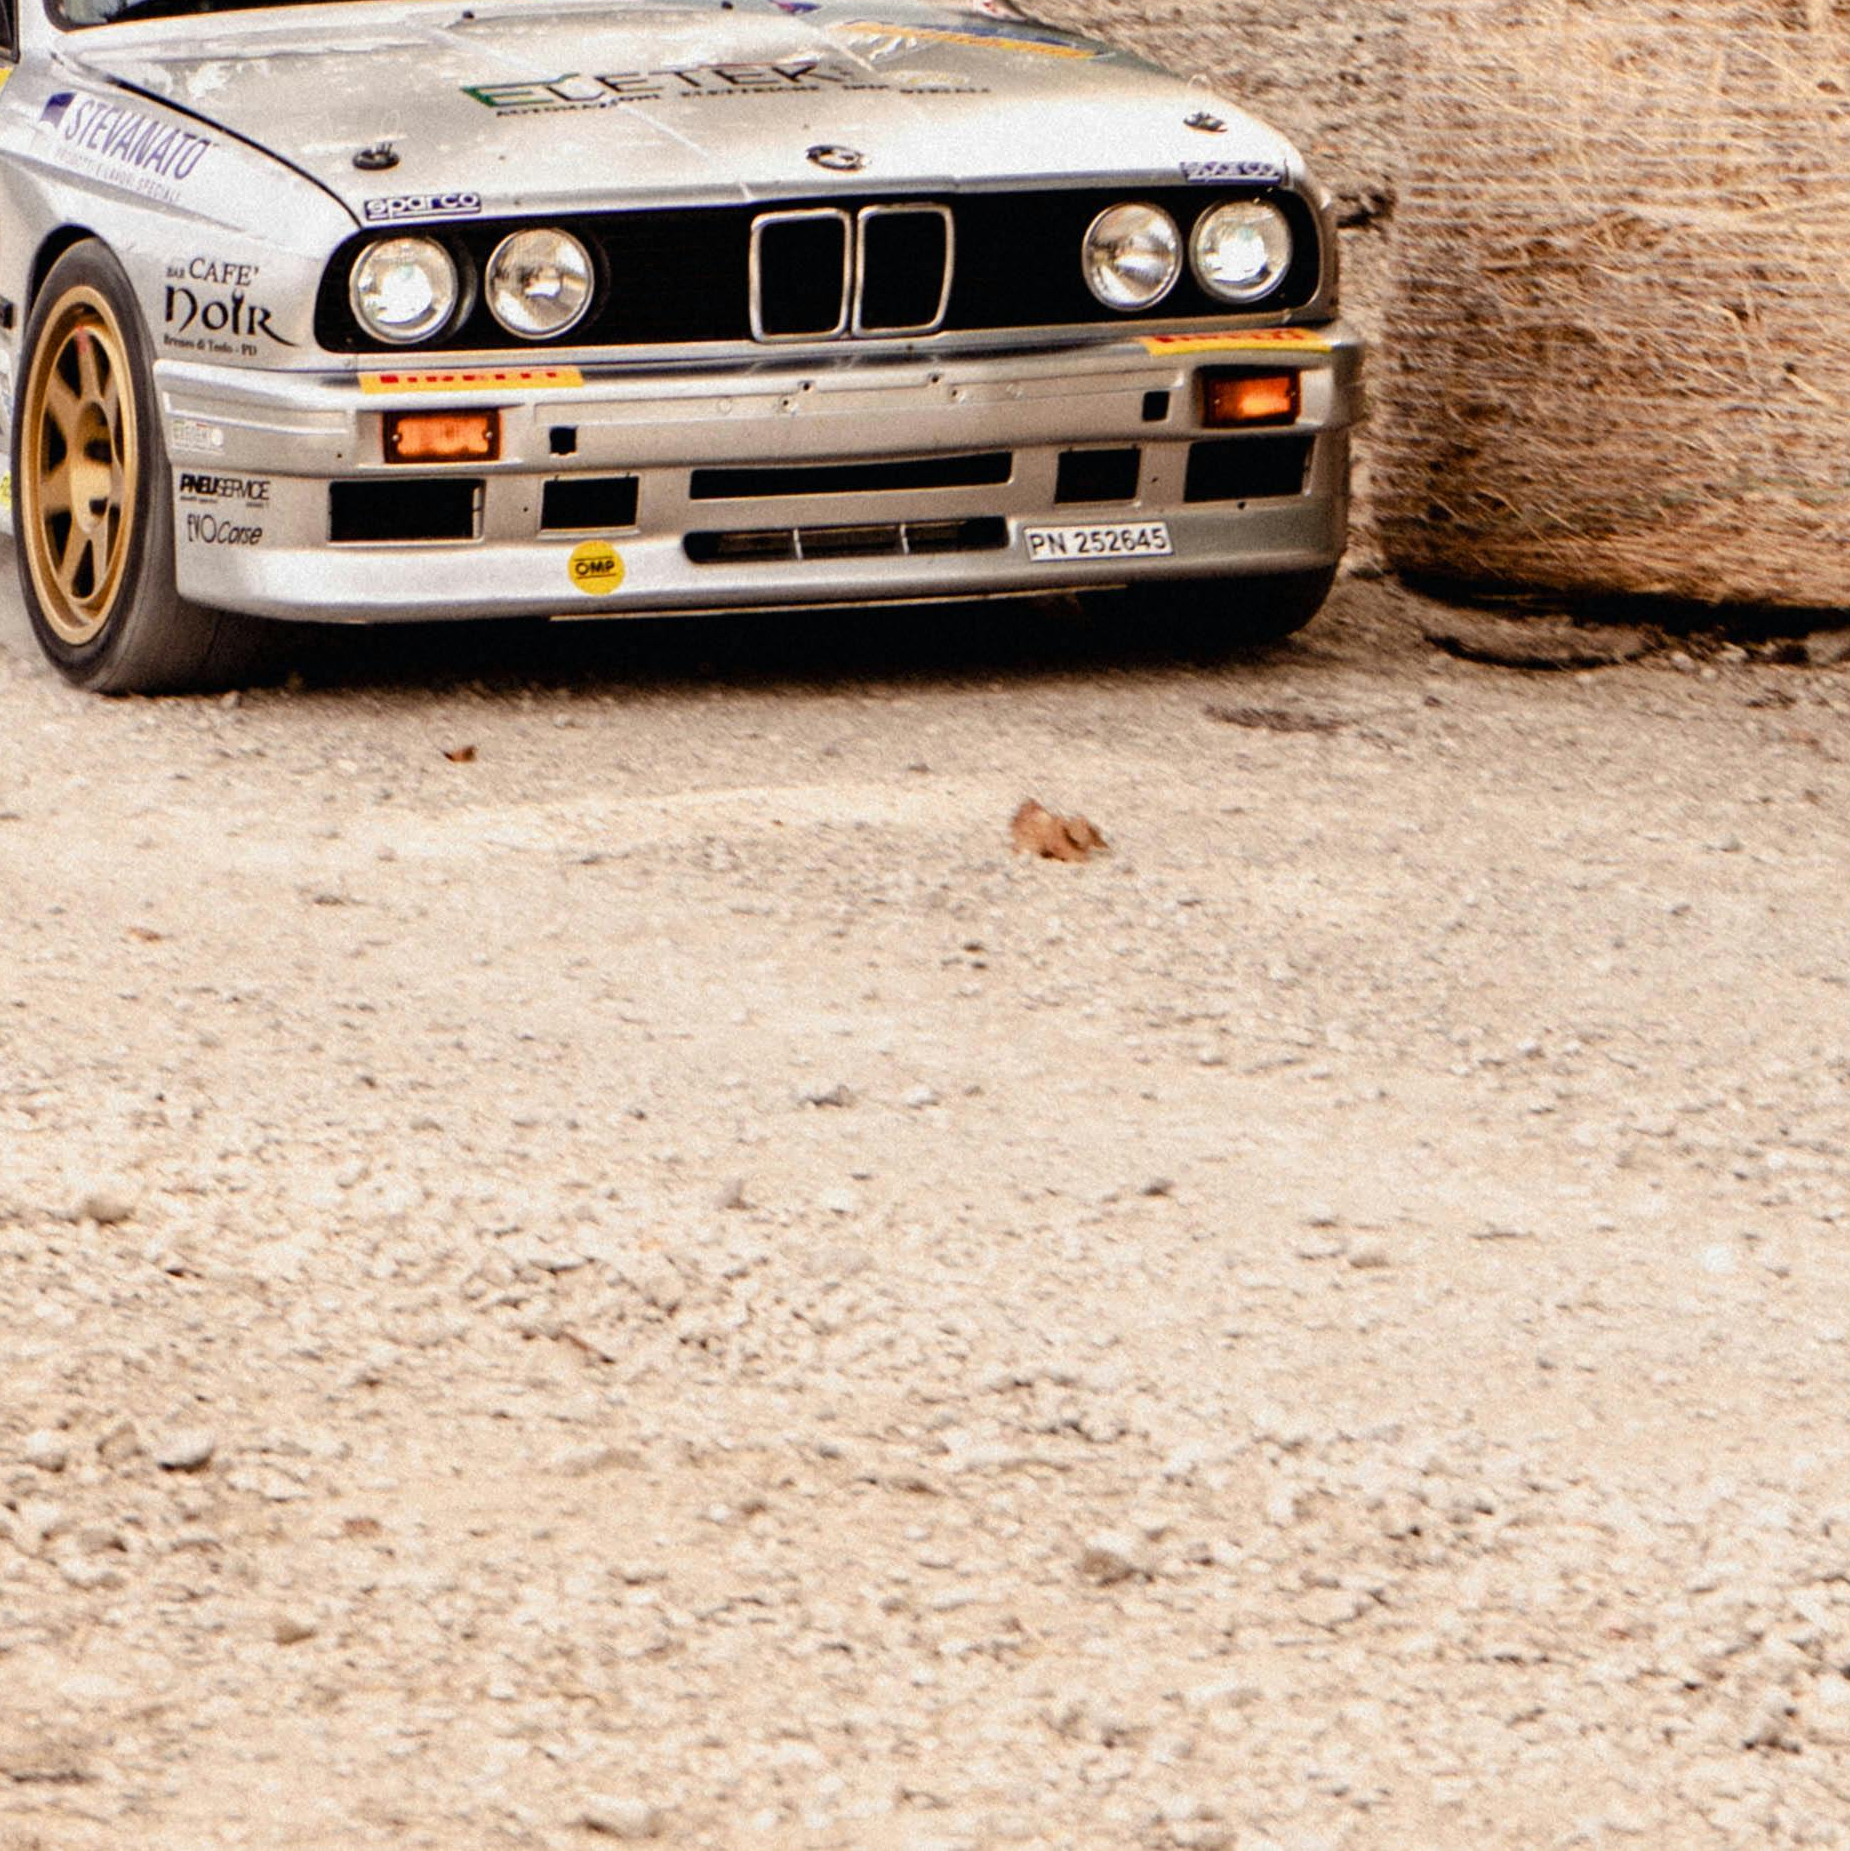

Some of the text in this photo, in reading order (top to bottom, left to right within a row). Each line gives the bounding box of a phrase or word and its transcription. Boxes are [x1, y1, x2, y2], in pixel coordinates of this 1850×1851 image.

[460, 61, 845, 108] ELETEK
[64, 99, 213, 180] STEVANATO
[1029, 526, 1167, 555] PN 252645
[575, 559, 615, 576] OMP
